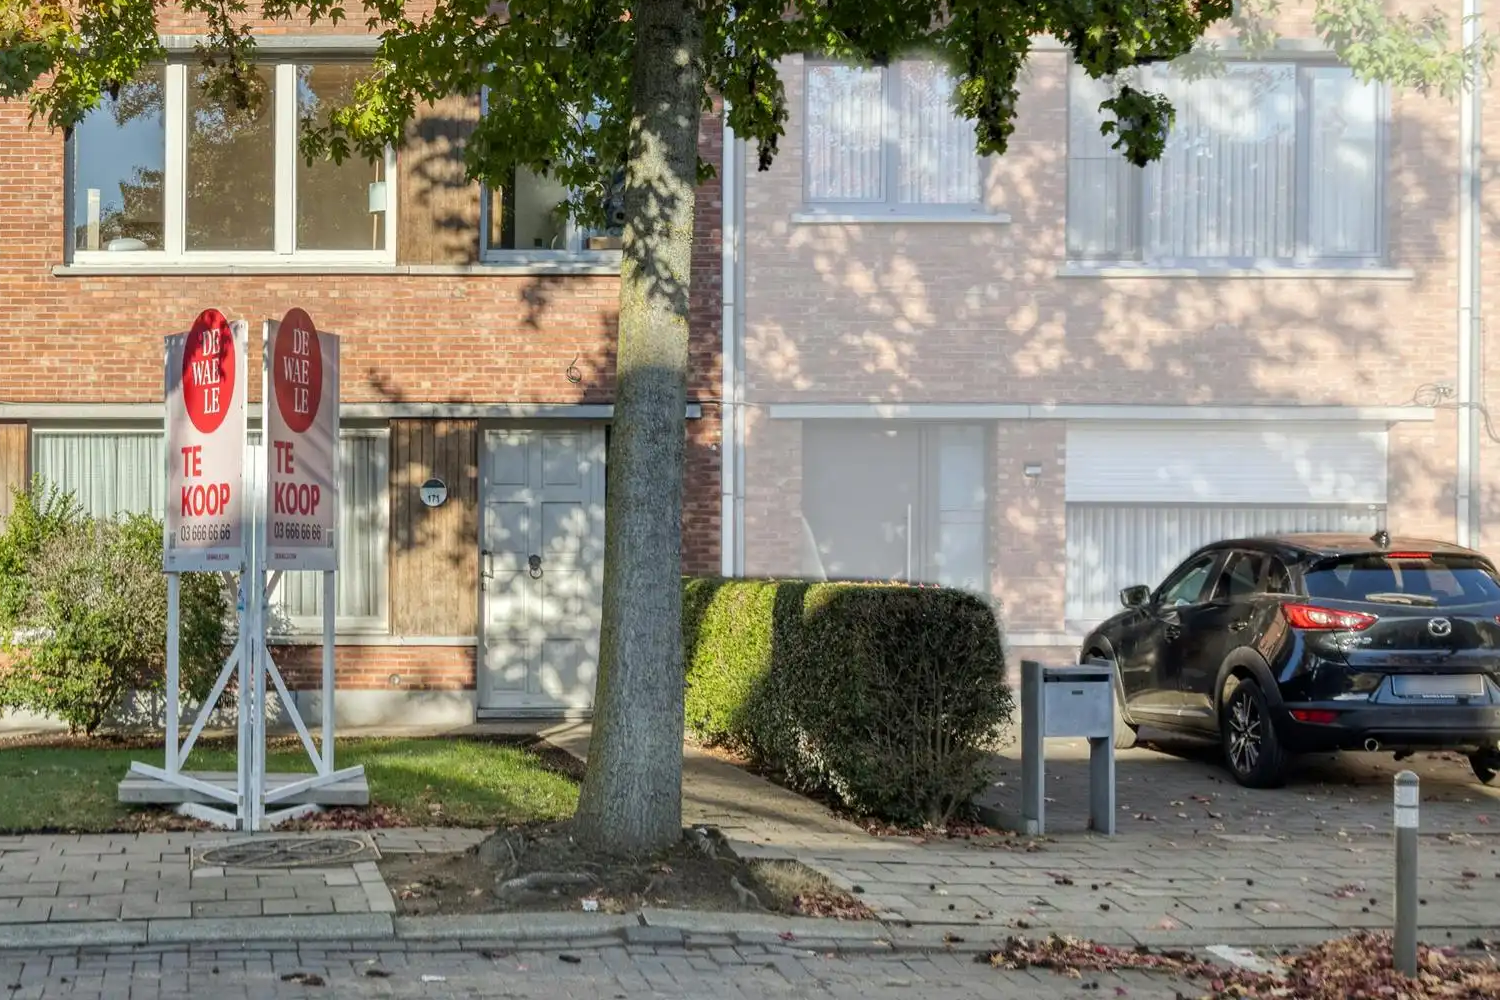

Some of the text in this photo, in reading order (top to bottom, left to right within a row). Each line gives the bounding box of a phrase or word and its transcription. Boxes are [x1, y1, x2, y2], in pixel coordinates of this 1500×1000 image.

[202, 328, 221, 356] DE
[293, 328, 310, 356] DE
[191, 358, 221, 387] WAE
[283, 355, 310, 385] WAE
[203, 387, 221, 415] LE
[293, 387, 309, 414] LE
[181, 445, 202, 478] TE
[273, 440, 295, 474] TE
[181, 482, 231, 517] KOOP
[274, 481, 321, 516] KOOP
[427, 494, 440, 503] 171
[180, 523, 231, 542] 03 666 66 66
[274, 521, 322, 541] 03 666 66 66
